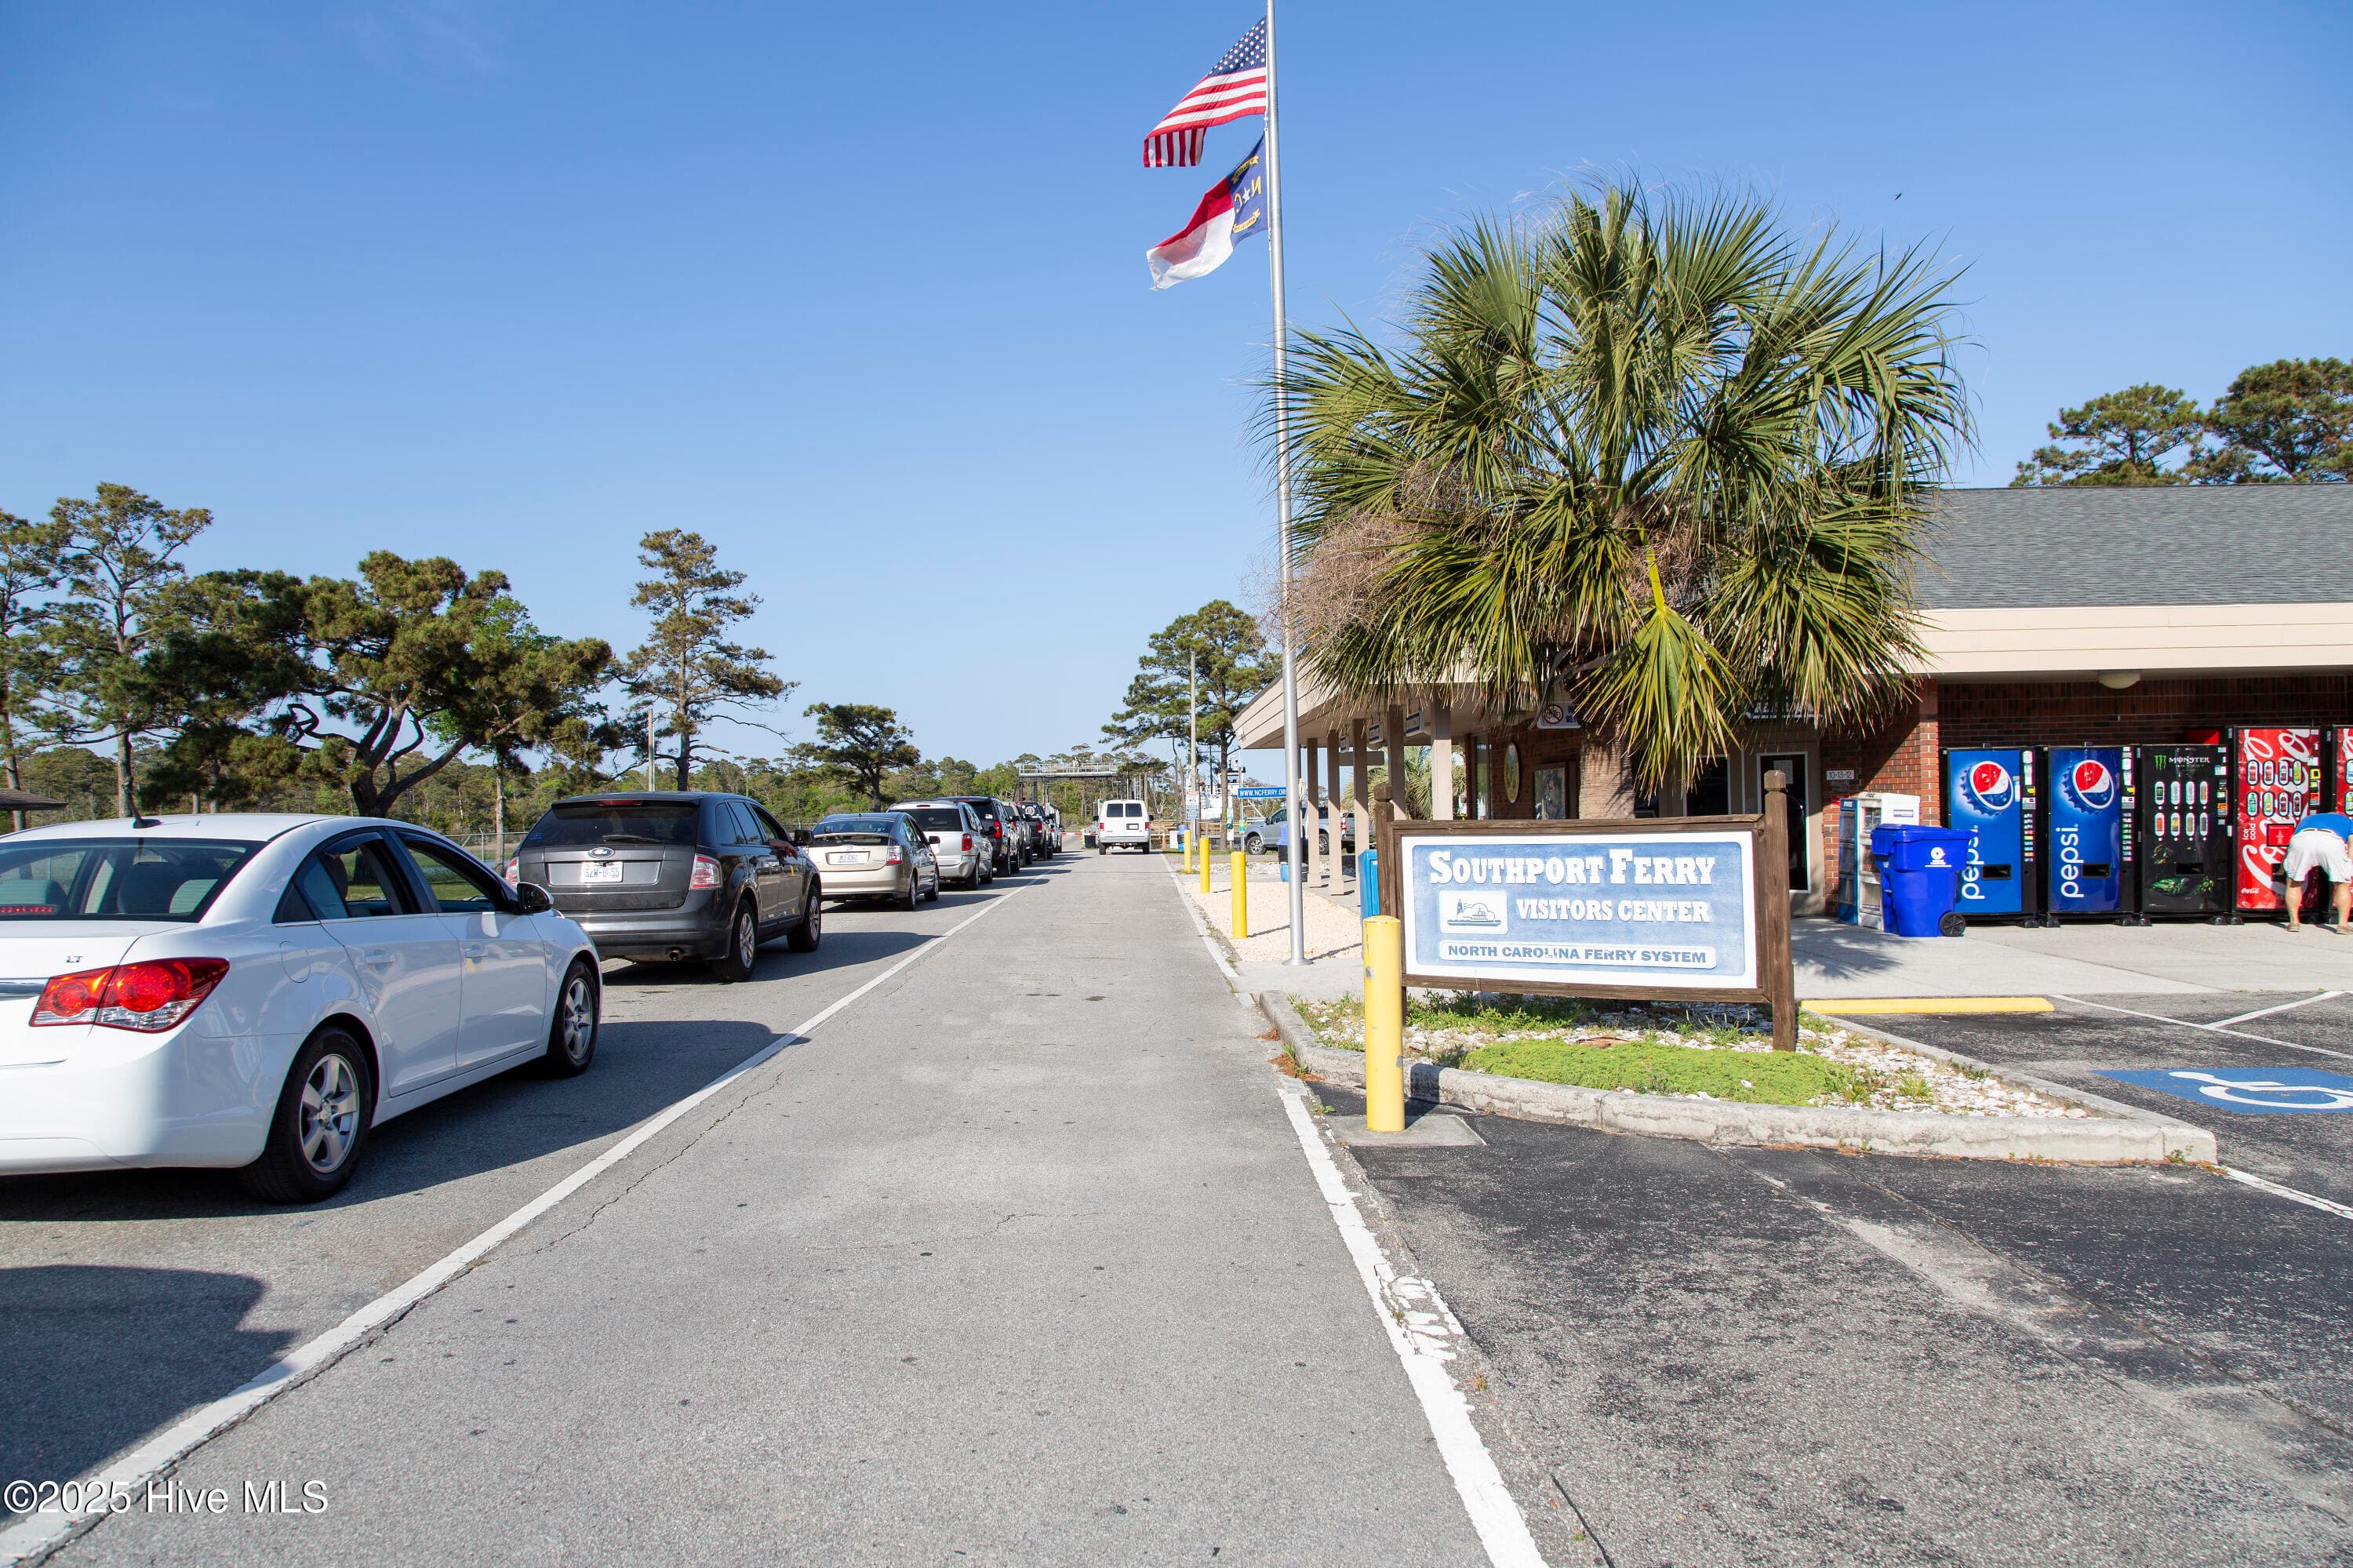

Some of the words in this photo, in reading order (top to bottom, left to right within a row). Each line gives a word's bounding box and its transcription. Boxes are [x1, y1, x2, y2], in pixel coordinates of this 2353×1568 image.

[1239, 788, 1286, 797] WWW.NCFERRY.OR
[1429, 850, 1604, 885] SOUTHPORT
[1609, 849, 1716, 886] FERRY
[2056, 827, 2085, 898] pepsi
[1516, 898, 1613, 922] VISITORS
[1617, 900, 1711, 923] CENTER
[1448, 945, 1497, 958] NORTH
[1502, 947, 1580, 959] CAROLINA
[1585, 949, 1636, 962] FERRY
[1641, 951, 1706, 963] SYSTEM
